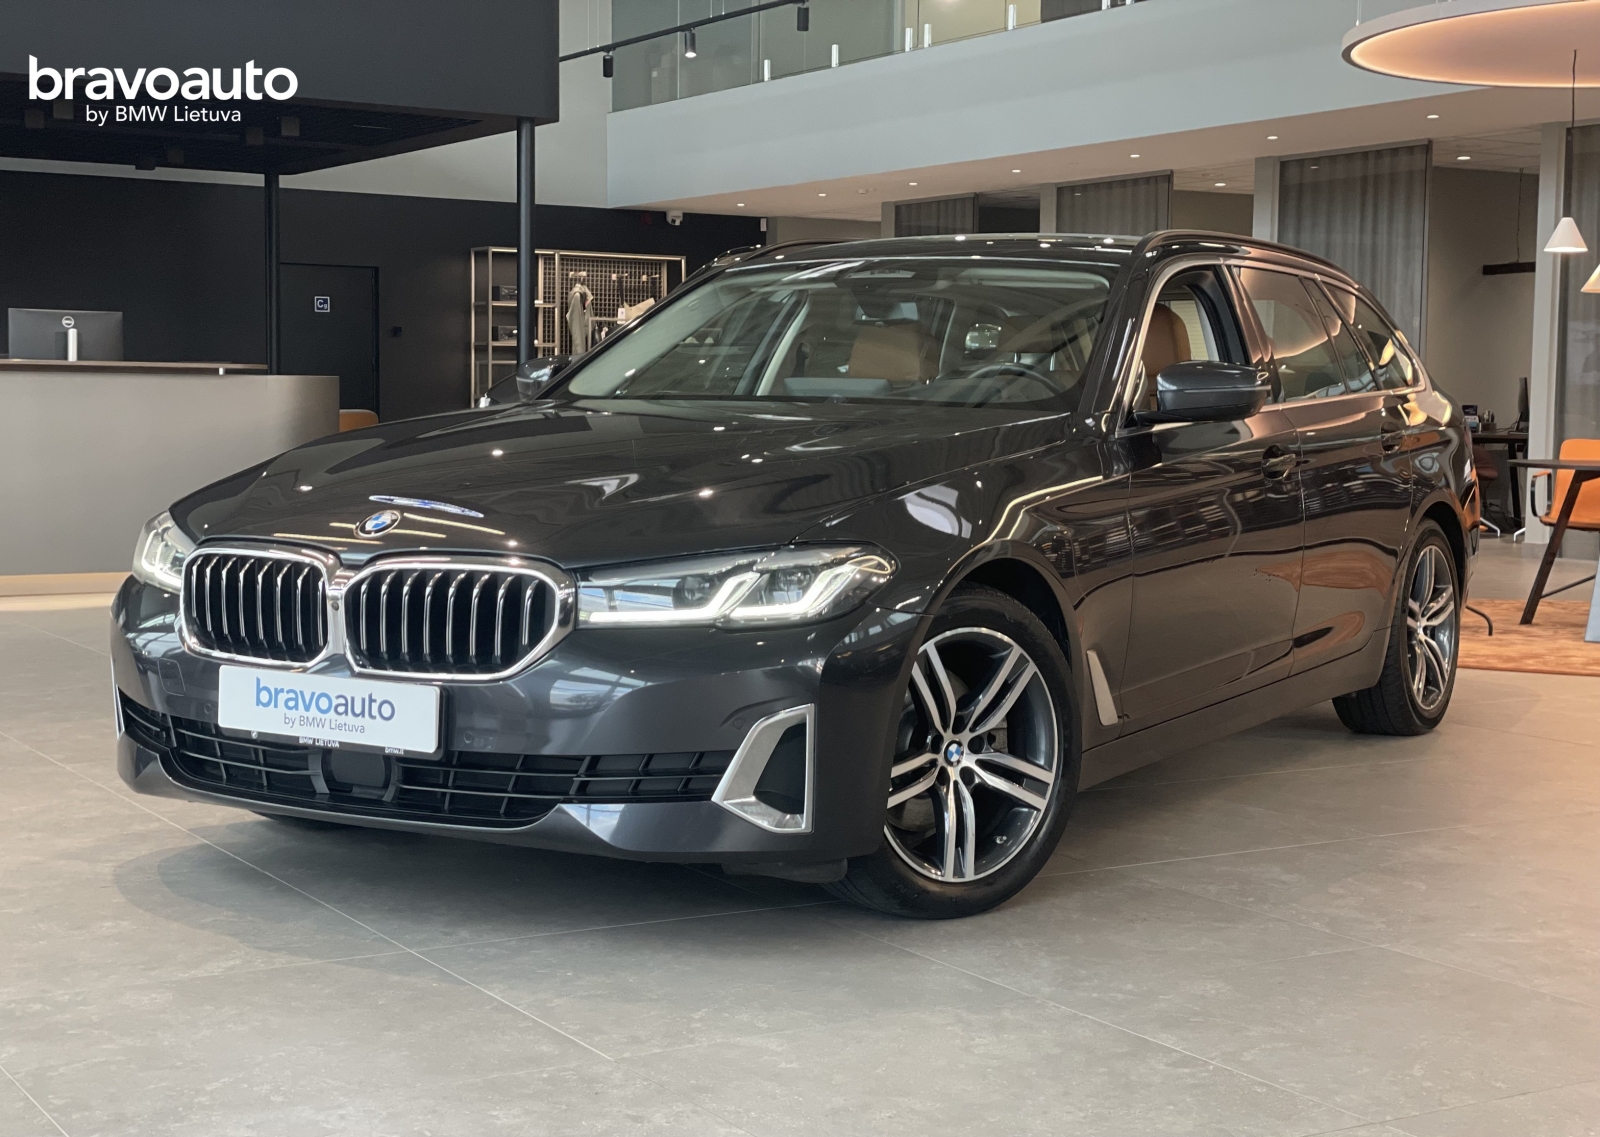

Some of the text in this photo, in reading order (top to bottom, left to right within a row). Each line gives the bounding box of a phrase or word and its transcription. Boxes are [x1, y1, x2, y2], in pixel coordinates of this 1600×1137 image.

[255, 676, 396, 722] bravoauto
[283, 712, 365, 734] by BMW Lietuva
[298, 736, 340, 748] BMW LIETUVA
